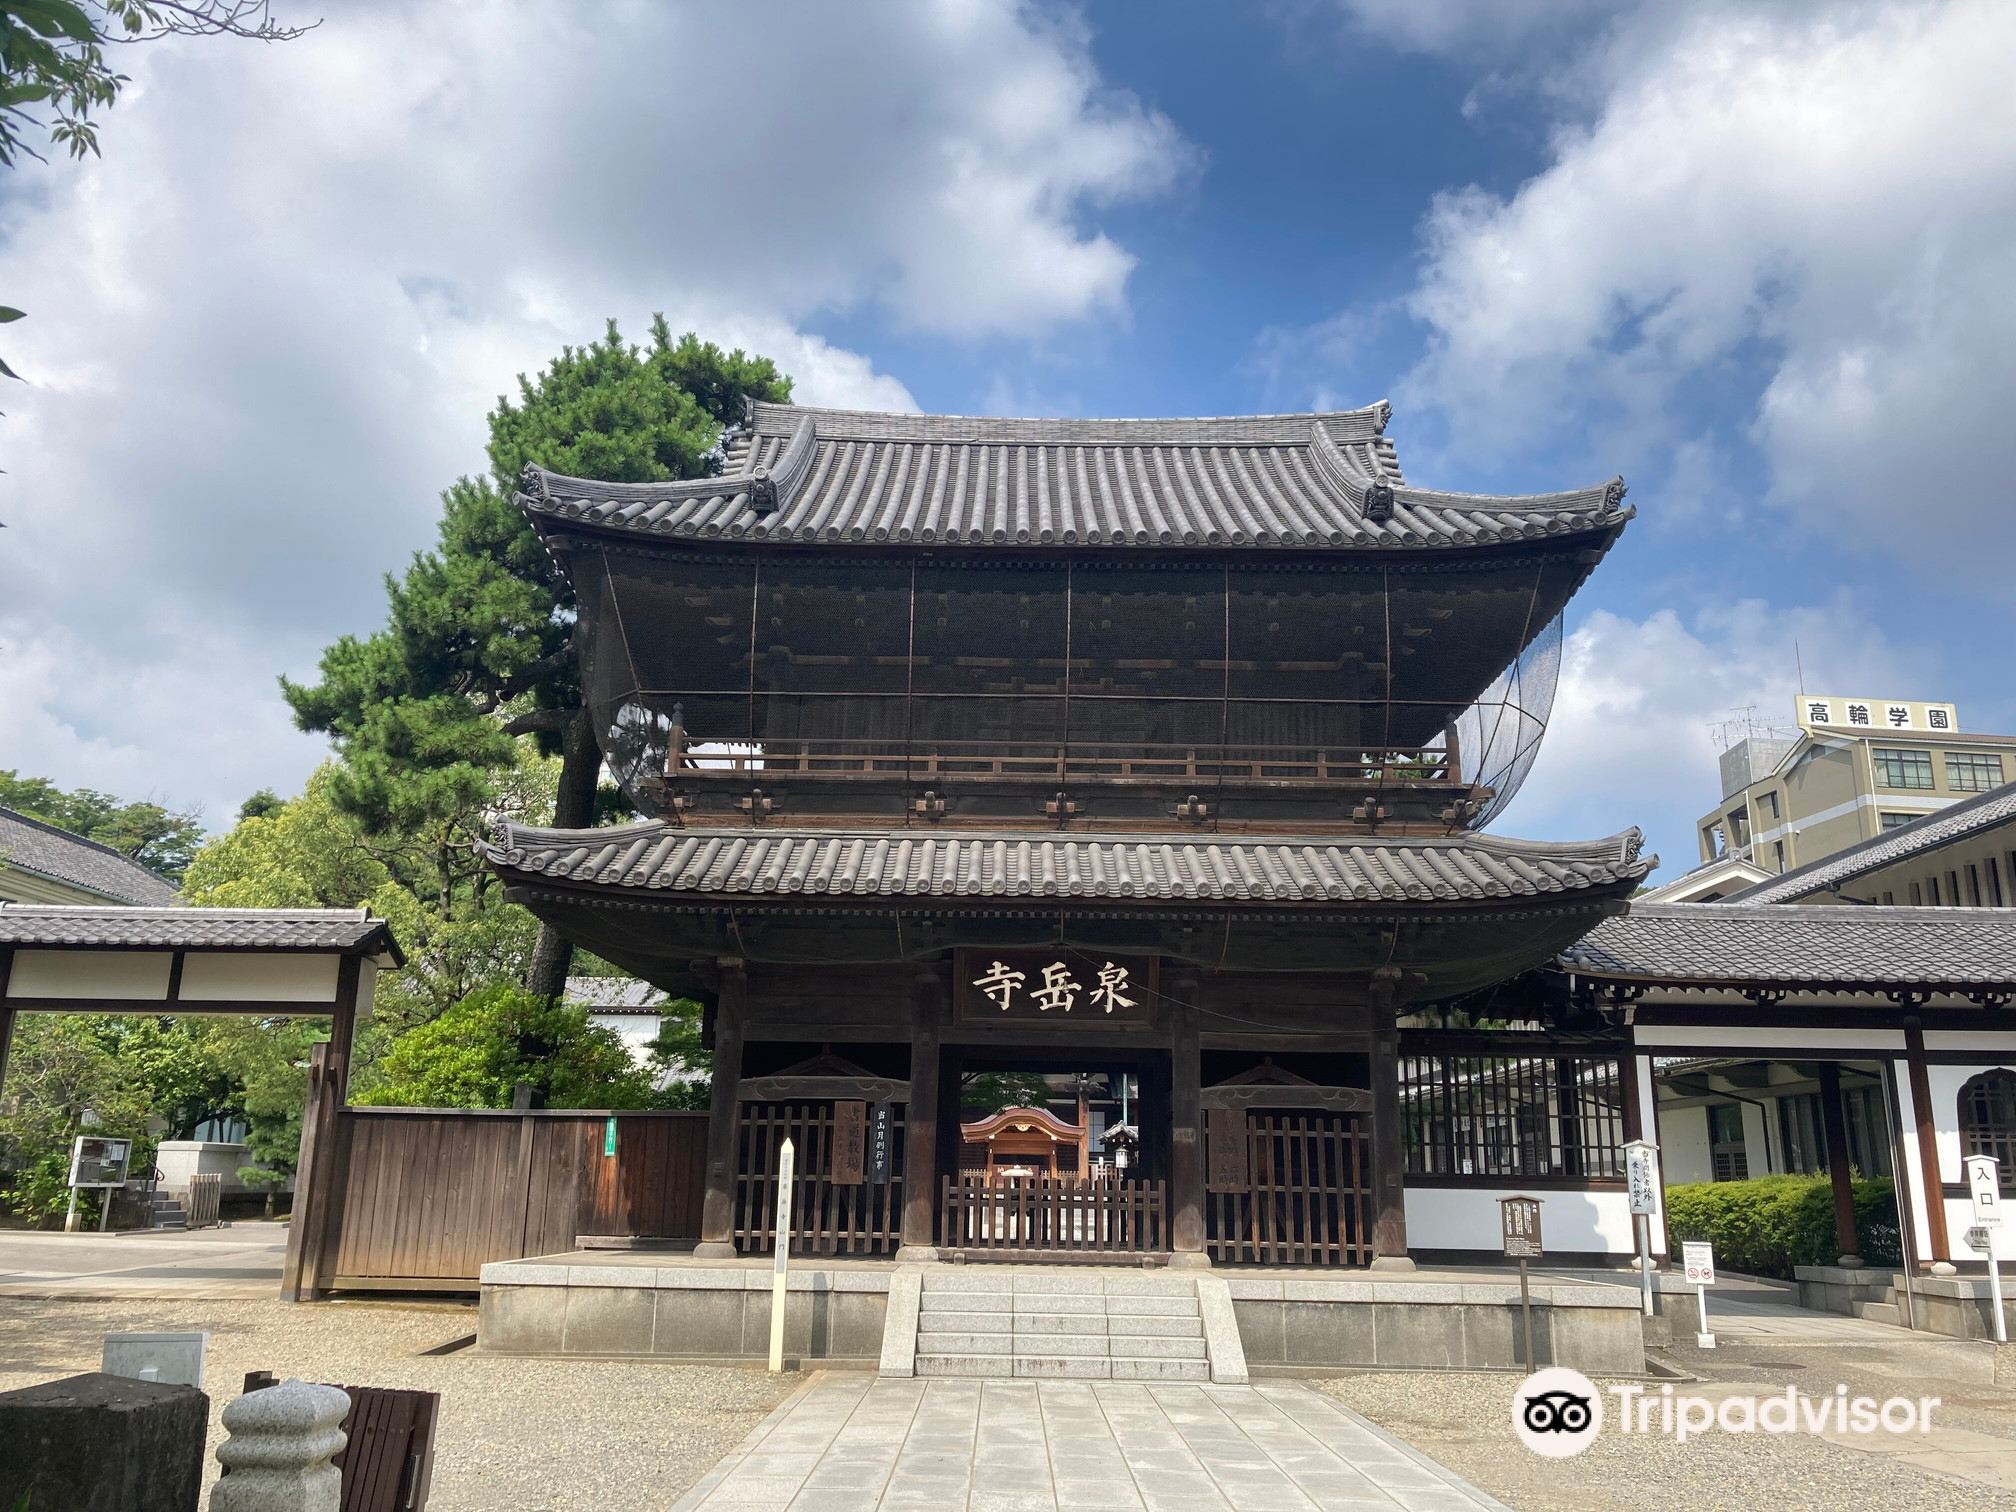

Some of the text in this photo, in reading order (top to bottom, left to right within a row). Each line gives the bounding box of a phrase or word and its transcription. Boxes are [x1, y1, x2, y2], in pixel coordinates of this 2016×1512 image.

[1808, 703, 1948, 729] 高輪学園
[1977, 1167, 1993, 1206] 入口
